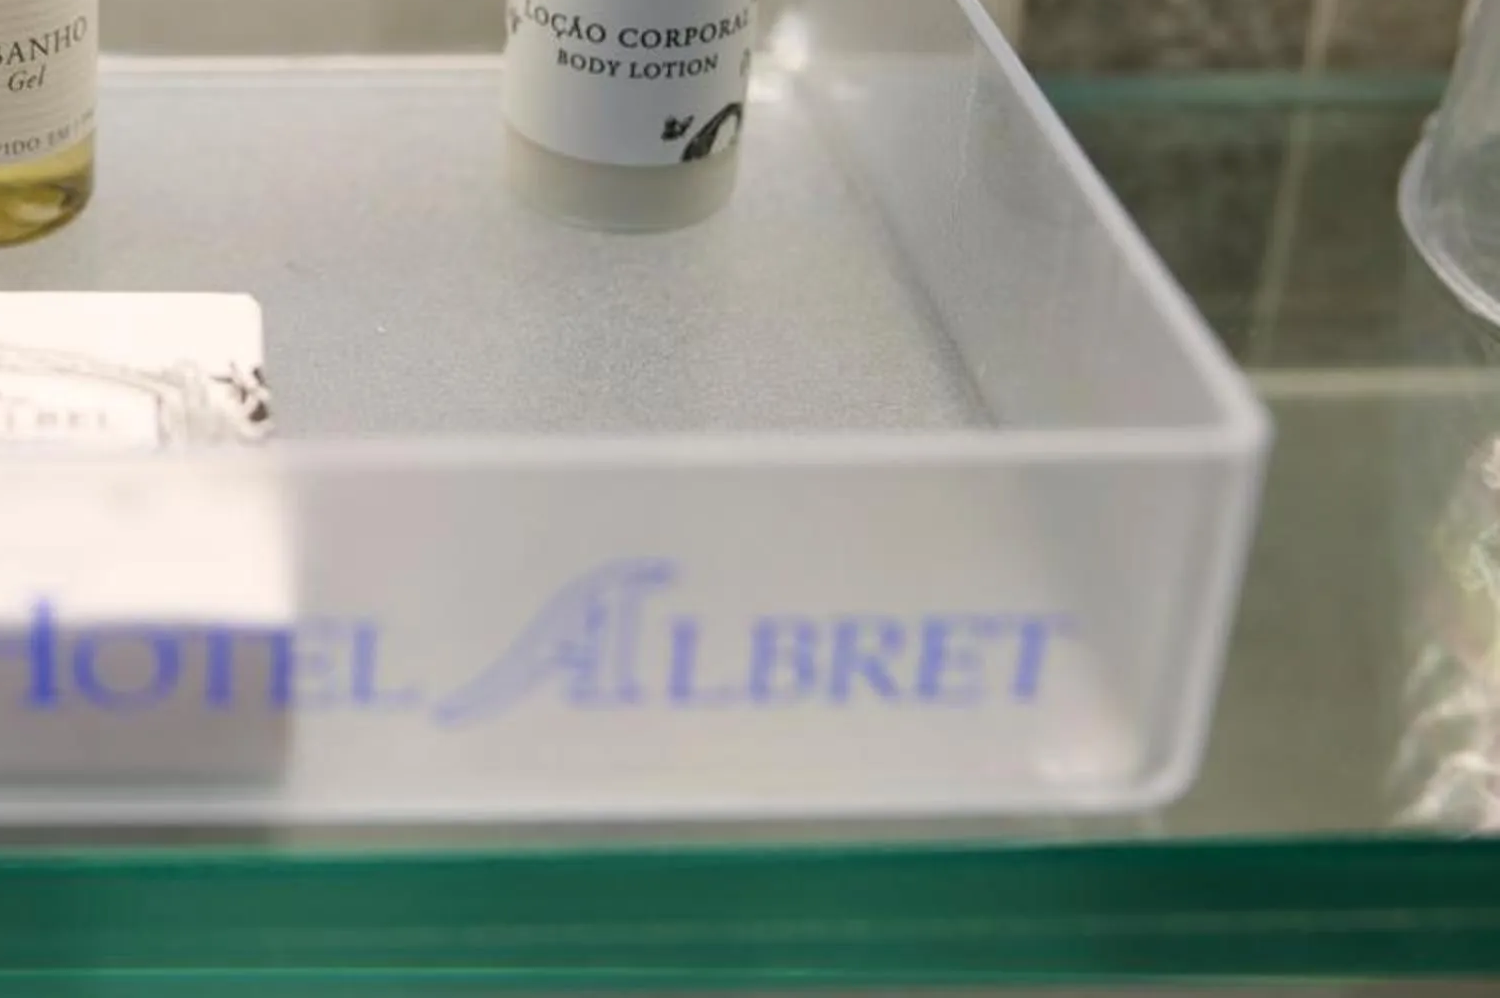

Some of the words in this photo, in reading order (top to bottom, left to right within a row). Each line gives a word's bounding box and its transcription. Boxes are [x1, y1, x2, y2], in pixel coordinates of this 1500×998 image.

[618, 7, 749, 50] CORPORAL
[7, 64, 47, 92] Gel
[556, 48, 622, 79] BODY
[629, 53, 720, 80] LOTION
[430, 556, 1082, 727] ALBRET
